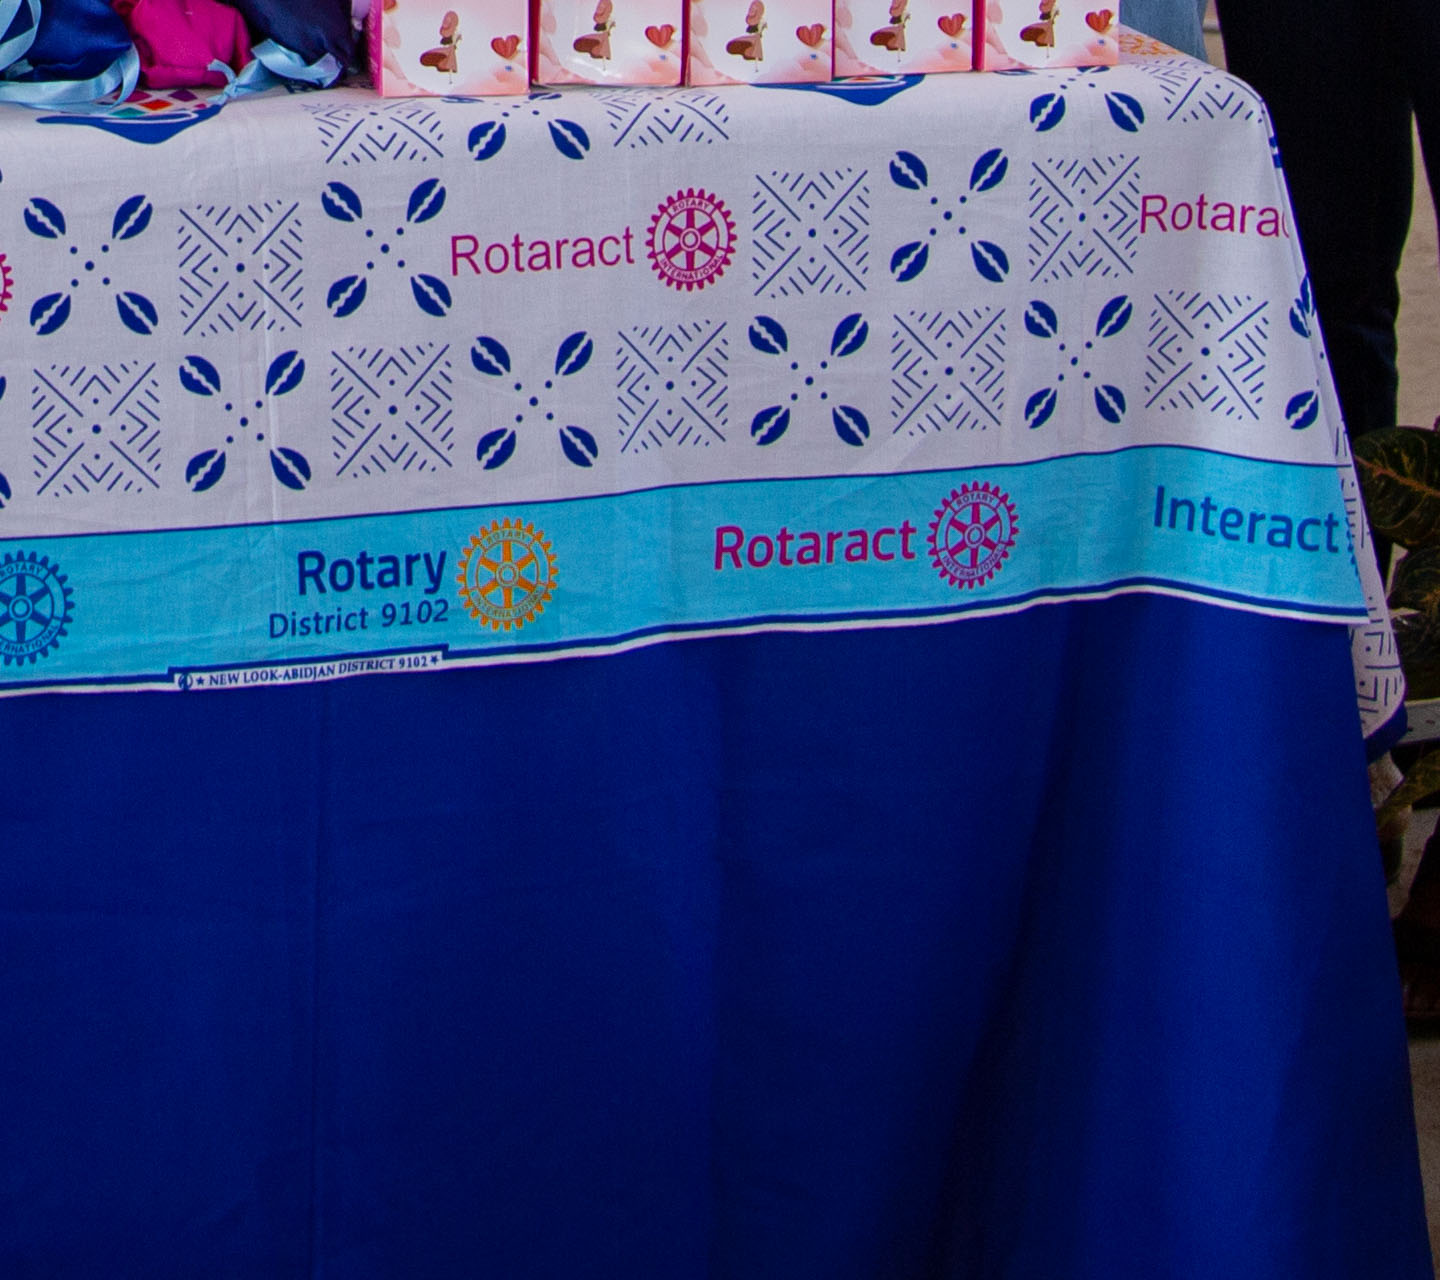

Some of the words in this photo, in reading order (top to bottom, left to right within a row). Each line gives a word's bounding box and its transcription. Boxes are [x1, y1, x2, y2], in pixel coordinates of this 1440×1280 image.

[672, 199, 710, 213] ROTARY
[1140, 194, 1290, 239] Rotara
[451, 225, 635, 276] Rotaract
[660, 254, 723, 282] INTERNATIONAL
[956, 492, 995, 508] ROTARY
[1154, 485, 1339, 553] Interact
[714, 520, 916, 570] Rotaract
[0, 561, 43, 578] ROTARY
[297, 550, 447, 596] Rotary
[269, 607, 368, 639] District
[381, 599, 449, 627] 9102
[209, 674, 239, 686] NEW
[242, 664, 336, 683] LOOK-ABIDJAN
[338, 658, 396, 673] DISTRICT
[399, 655, 428, 668] 9102
